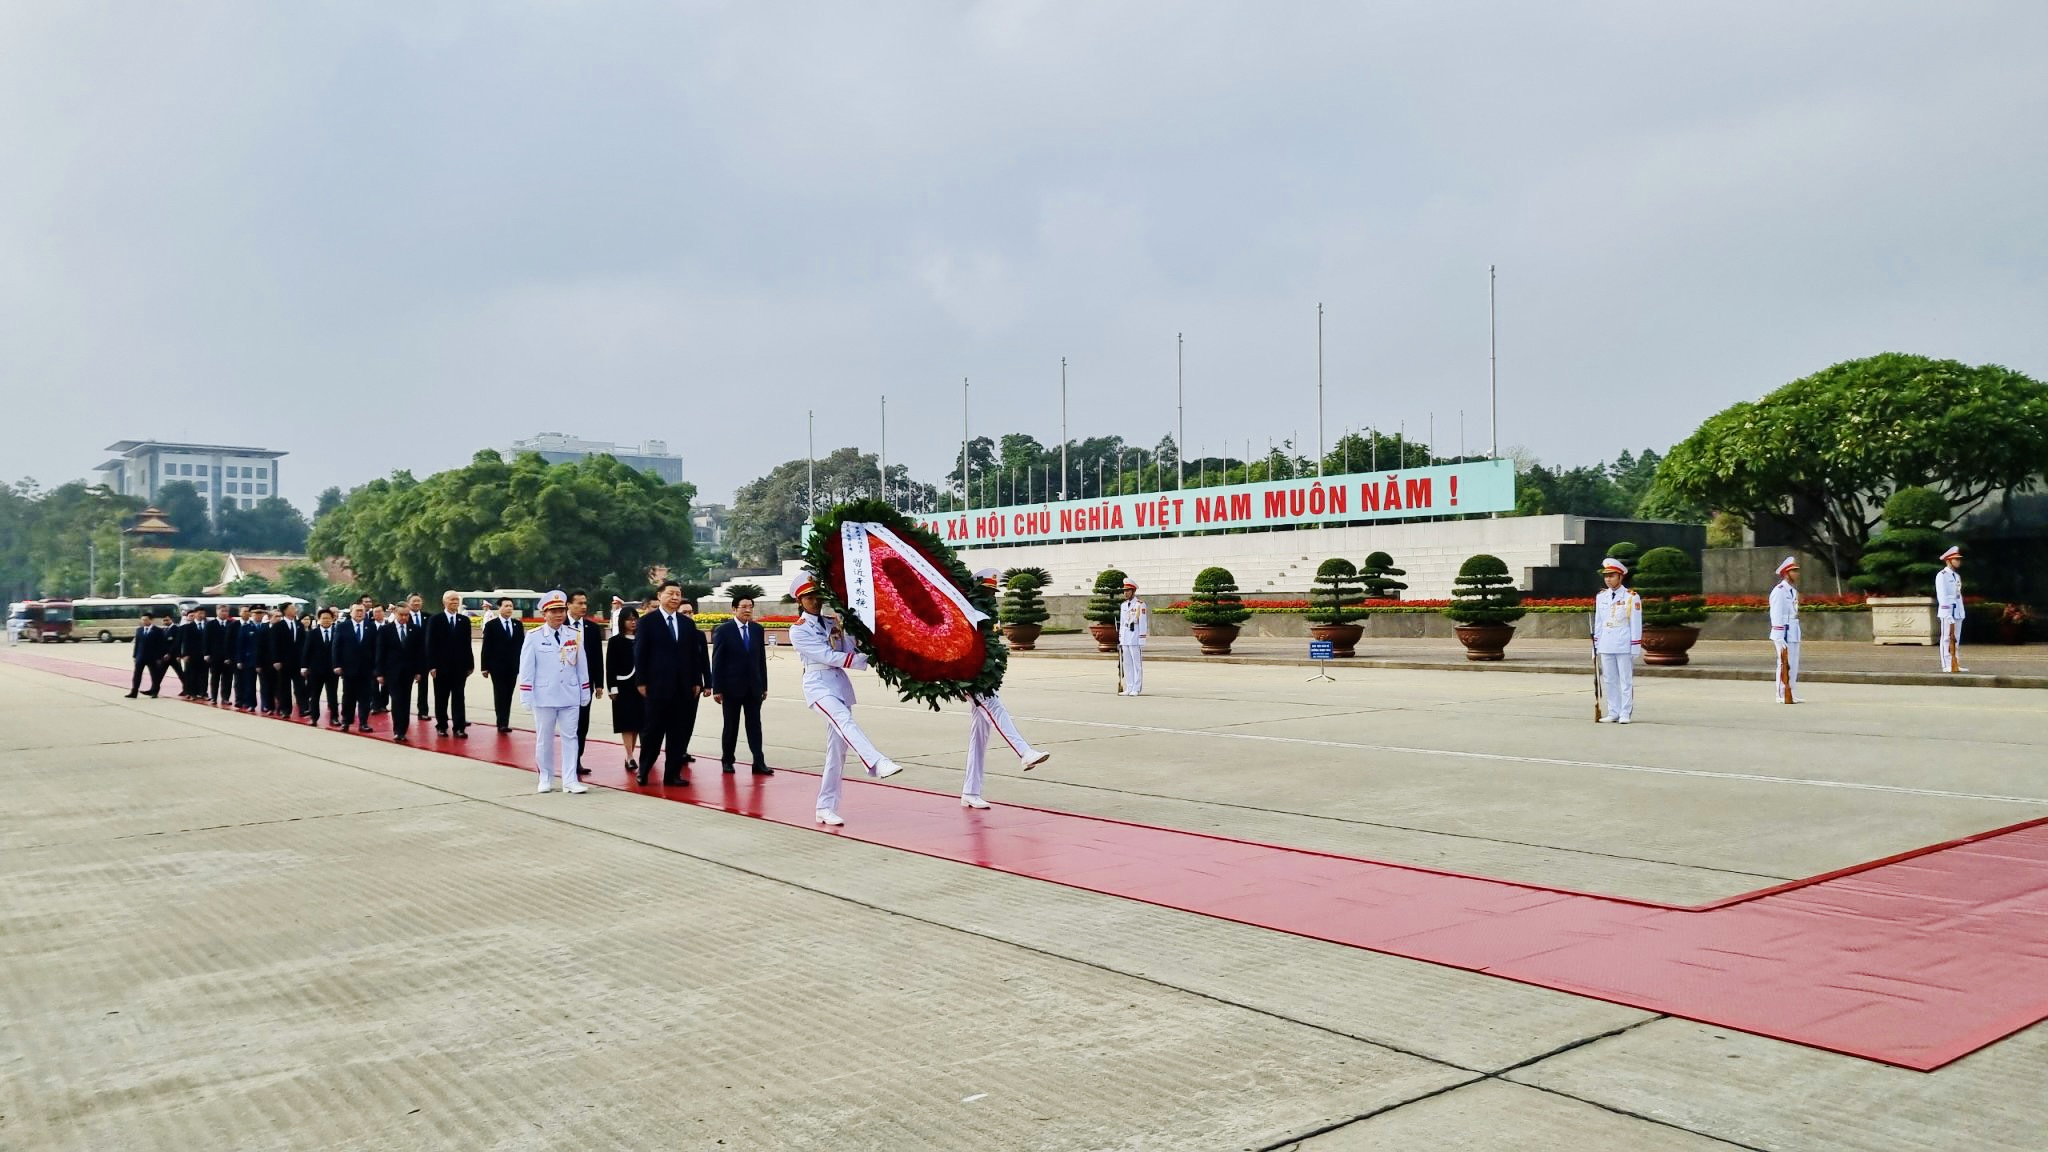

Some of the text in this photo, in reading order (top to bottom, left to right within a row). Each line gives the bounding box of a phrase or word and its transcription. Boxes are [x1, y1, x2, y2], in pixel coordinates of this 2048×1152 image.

[947, 514, 969, 540] XÃ
[977, 511, 1006, 541] HỘI
[1013, 504, 1051, 536] CHỦ
[1060, 501, 1124, 533] NGHĨA
[1135, 496, 1184, 531] VIỆT
[1195, 493, 1252, 522] NAM
[1264, 481, 1347, 518] MUÔN
[1361, 474, 1432, 512] NĂM
[1449, 475, 1458, 506] !
